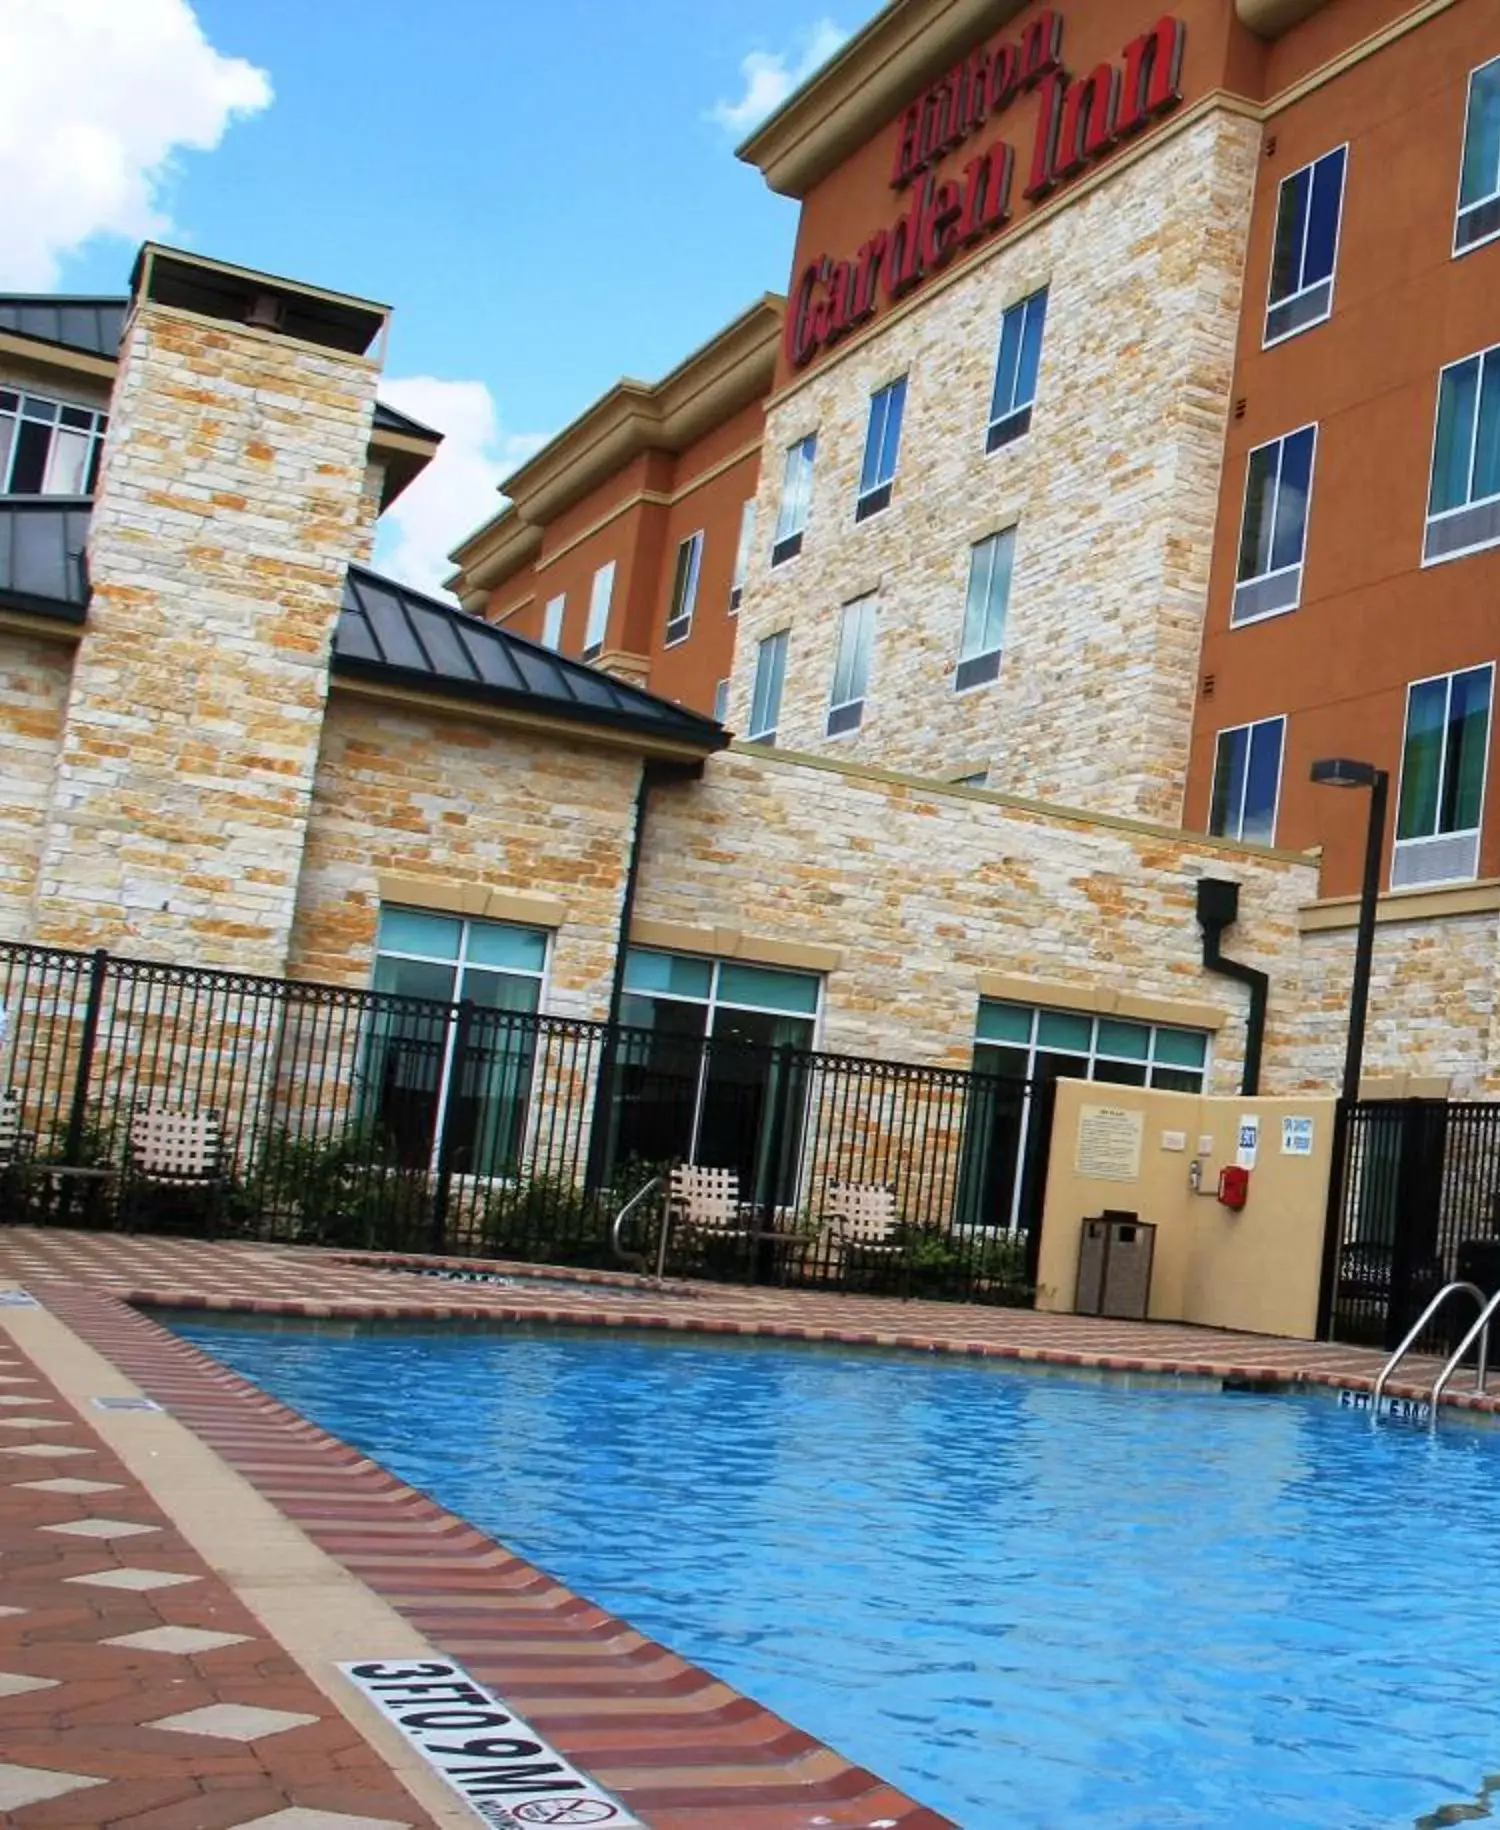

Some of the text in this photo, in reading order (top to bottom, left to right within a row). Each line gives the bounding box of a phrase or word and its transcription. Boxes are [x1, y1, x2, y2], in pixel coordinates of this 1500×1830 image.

[783, 14, 1185, 369] Garden Inn
[890, 9, 1063, 190] Hilton
